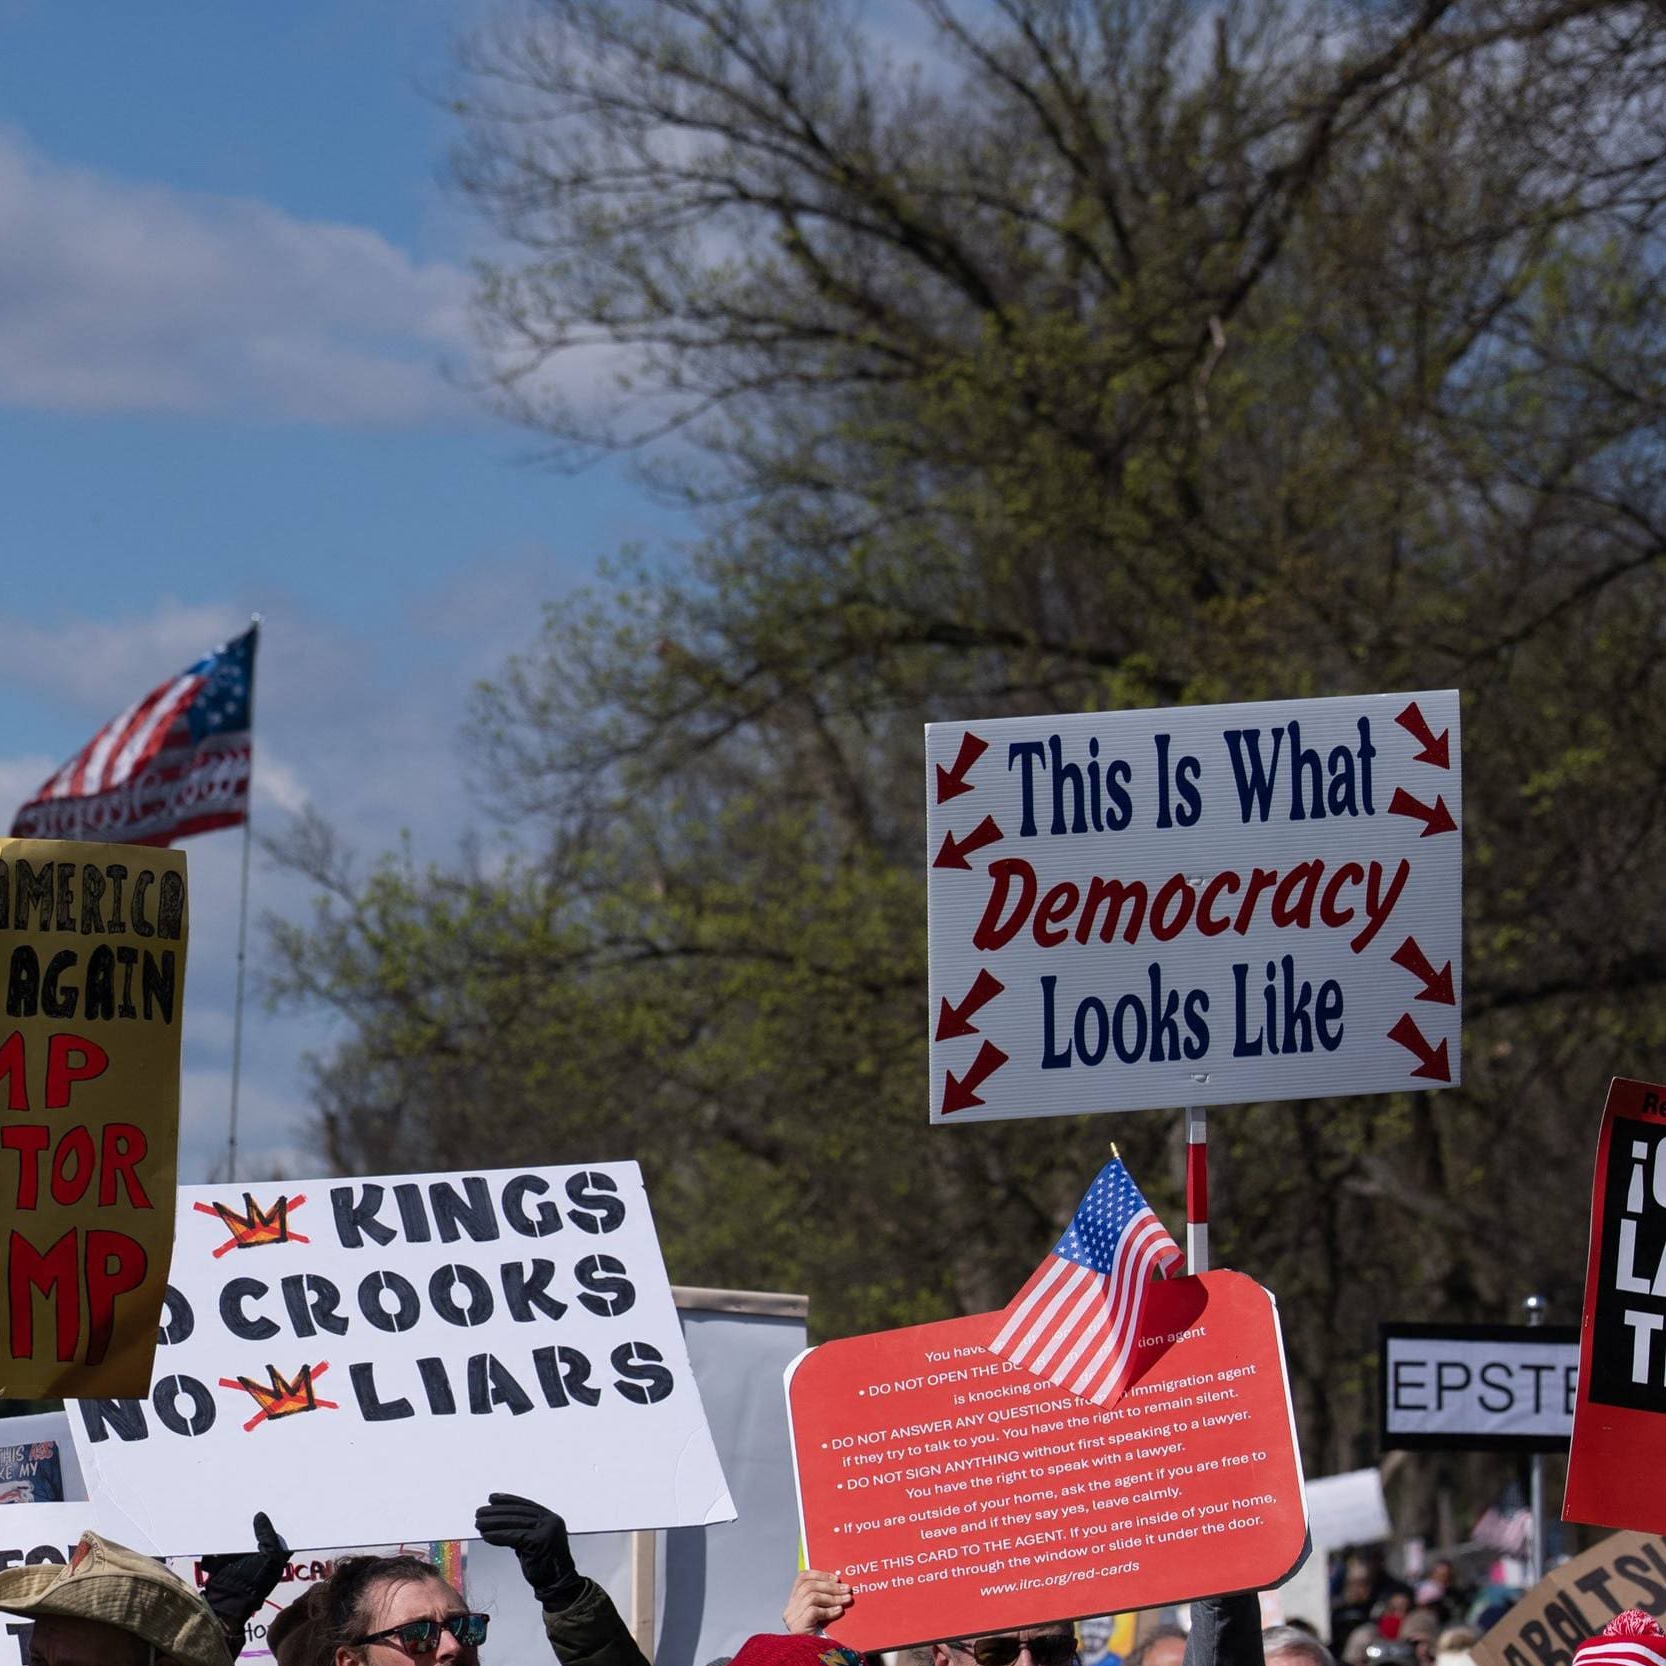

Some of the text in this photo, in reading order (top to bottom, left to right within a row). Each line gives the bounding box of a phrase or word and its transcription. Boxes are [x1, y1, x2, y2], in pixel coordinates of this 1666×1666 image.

[1008, 716, 1377, 837] This Is What
[972, 858, 1410, 954] Democracy
[5, 943, 175, 1024] AGAIN
[1040, 954, 1344, 1069] Looks Like
[329, 1170, 627, 1250] KINGS
[218, 1254, 637, 1343] CROOKS
[85, 1341, 674, 1444] NO LIARS
[868, 1326, 1206, 1396] DO NOT OPEN THE agent
[924, 1346, 985, 1362] You have
[953, 1394, 965, 1404] is
[968, 1383, 1031, 1402] knocking
[1033, 1379, 1050, 1390] on
[831, 1436, 853, 1449] DO
[857, 1430, 886, 1445] NOT
[890, 1419, 952, 1439] ANSWER
[955, 1413, 984, 1428] ANY
[987, 1398, 1071, 1423] QUESTIONS
[1131, 1374, 1213, 1396] immigration
[1217, 1364, 1256, 1381] agent
[842, 1388, 1238, 1467] if they try to talk to you. You have the right to remain silent.
[19, 1462, 39, 1477] MY
[847, 1410, 1251, 1489] DO NOT SIGN ANYTHING without first speaking to a lawyer.
[843, 1451, 1266, 1533] If you are outside of your home, ask the agent if you are free to
[980, 1561, 1139, 1596] www.ilrc.org/red-cards
